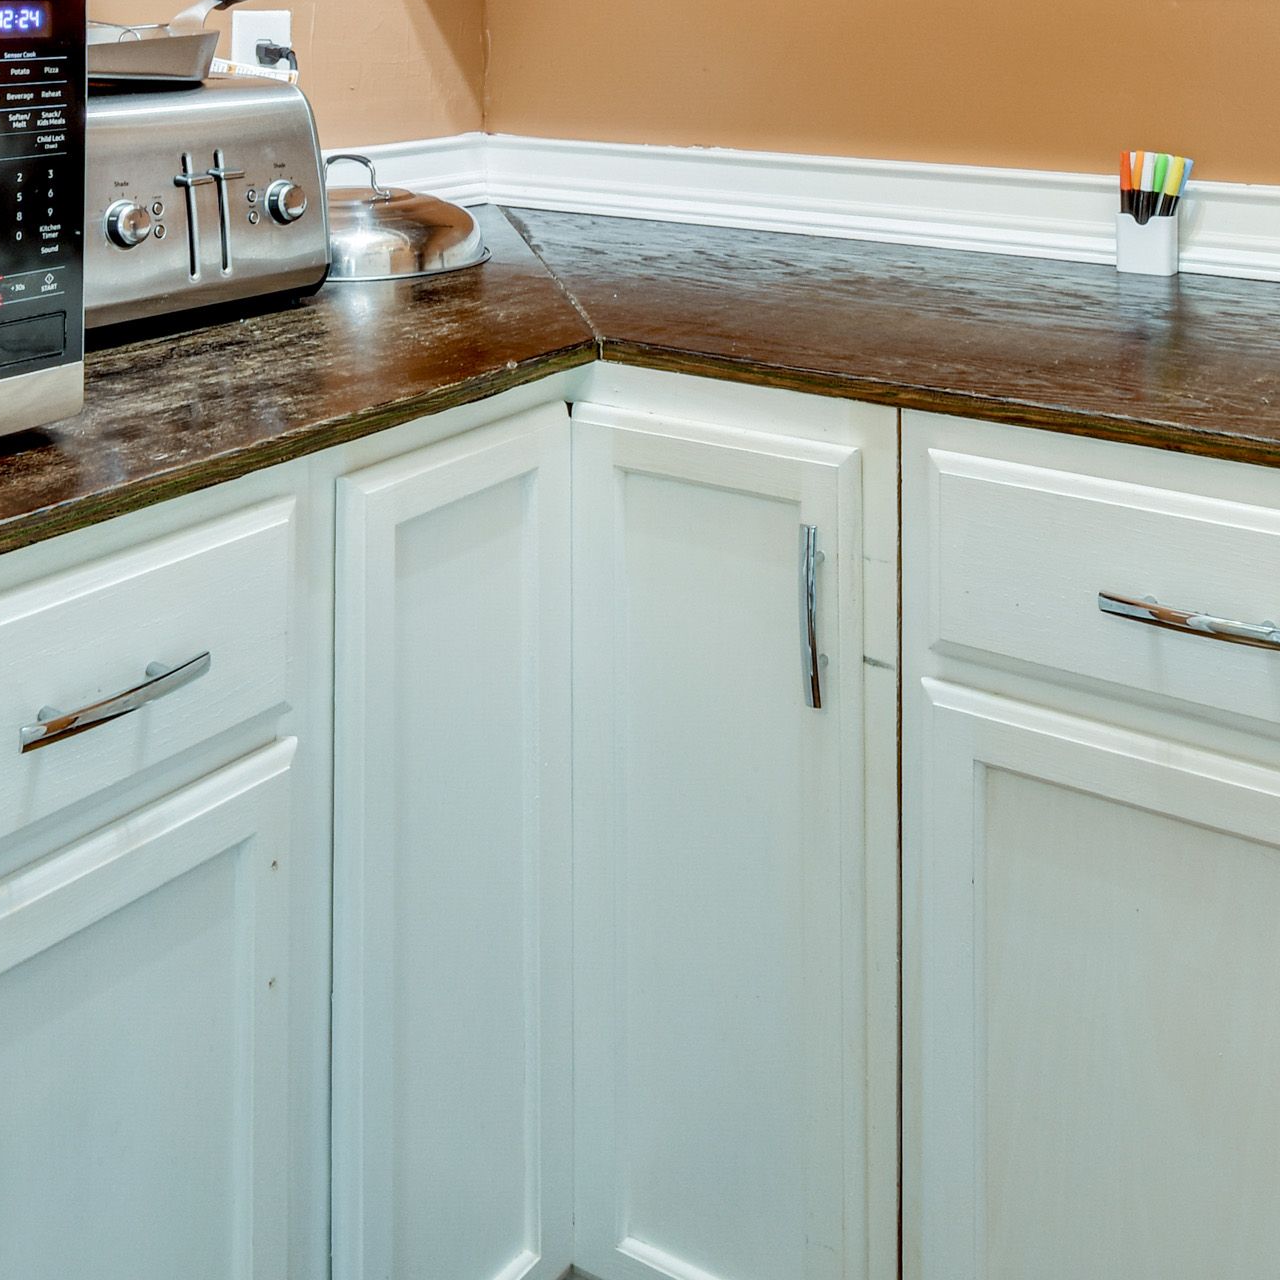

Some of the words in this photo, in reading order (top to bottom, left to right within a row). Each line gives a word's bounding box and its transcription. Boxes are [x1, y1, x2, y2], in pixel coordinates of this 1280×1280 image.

[3, 51, 22, 59] Sensor
[23, 50, 36, 58] Cook
[10, 67, 30, 76] Potato
[43, 66, 59, 74] Pizza
[6, 92, 34, 100] Beverage
[41, 90, 62, 98] Reheat
[8, 112, 31, 121] Soften/
[12, 121, 27, 129] Melt
[37, 118, 49, 126] Kids
[49, 117, 66, 126] Meals
[37, 134, 52, 143] Child
[52, 133, 65, 142] Lock
[16, 172, 23, 182] 2
[47, 169, 54, 179] 3
[16, 192, 23, 202] 5
[47, 188, 54, 198] 6
[16, 211, 23, 221] 8
[47, 207, 54, 217] 9
[39, 224, 61, 232] Kitchen
[16, 231, 23, 241] 0
[42, 231, 59, 240] Timer
[40, 244, 59, 254] Sound
[41, 283, 58, 292] START
